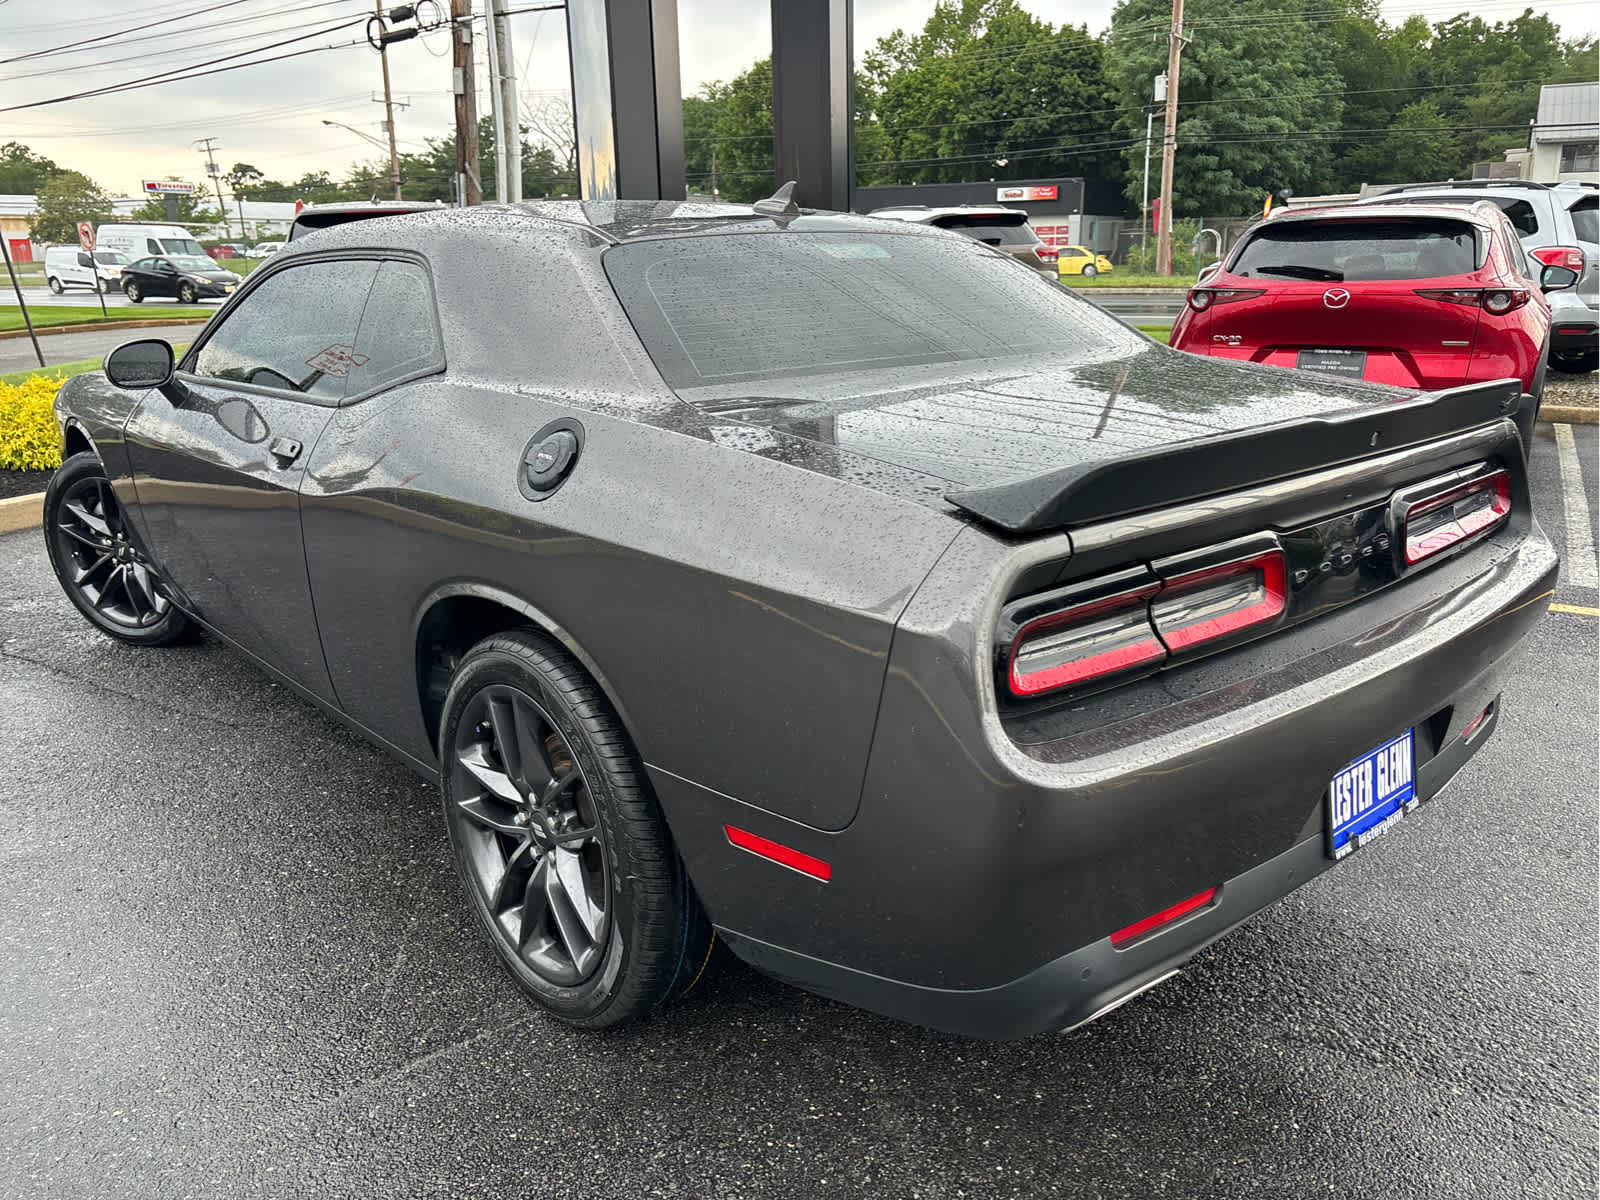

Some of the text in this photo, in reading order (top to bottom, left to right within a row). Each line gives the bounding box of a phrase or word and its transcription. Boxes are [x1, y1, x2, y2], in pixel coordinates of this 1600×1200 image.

[1295, 532, 1389, 584] DODGE
[1330, 736, 1411, 829] LESTER GLENN
